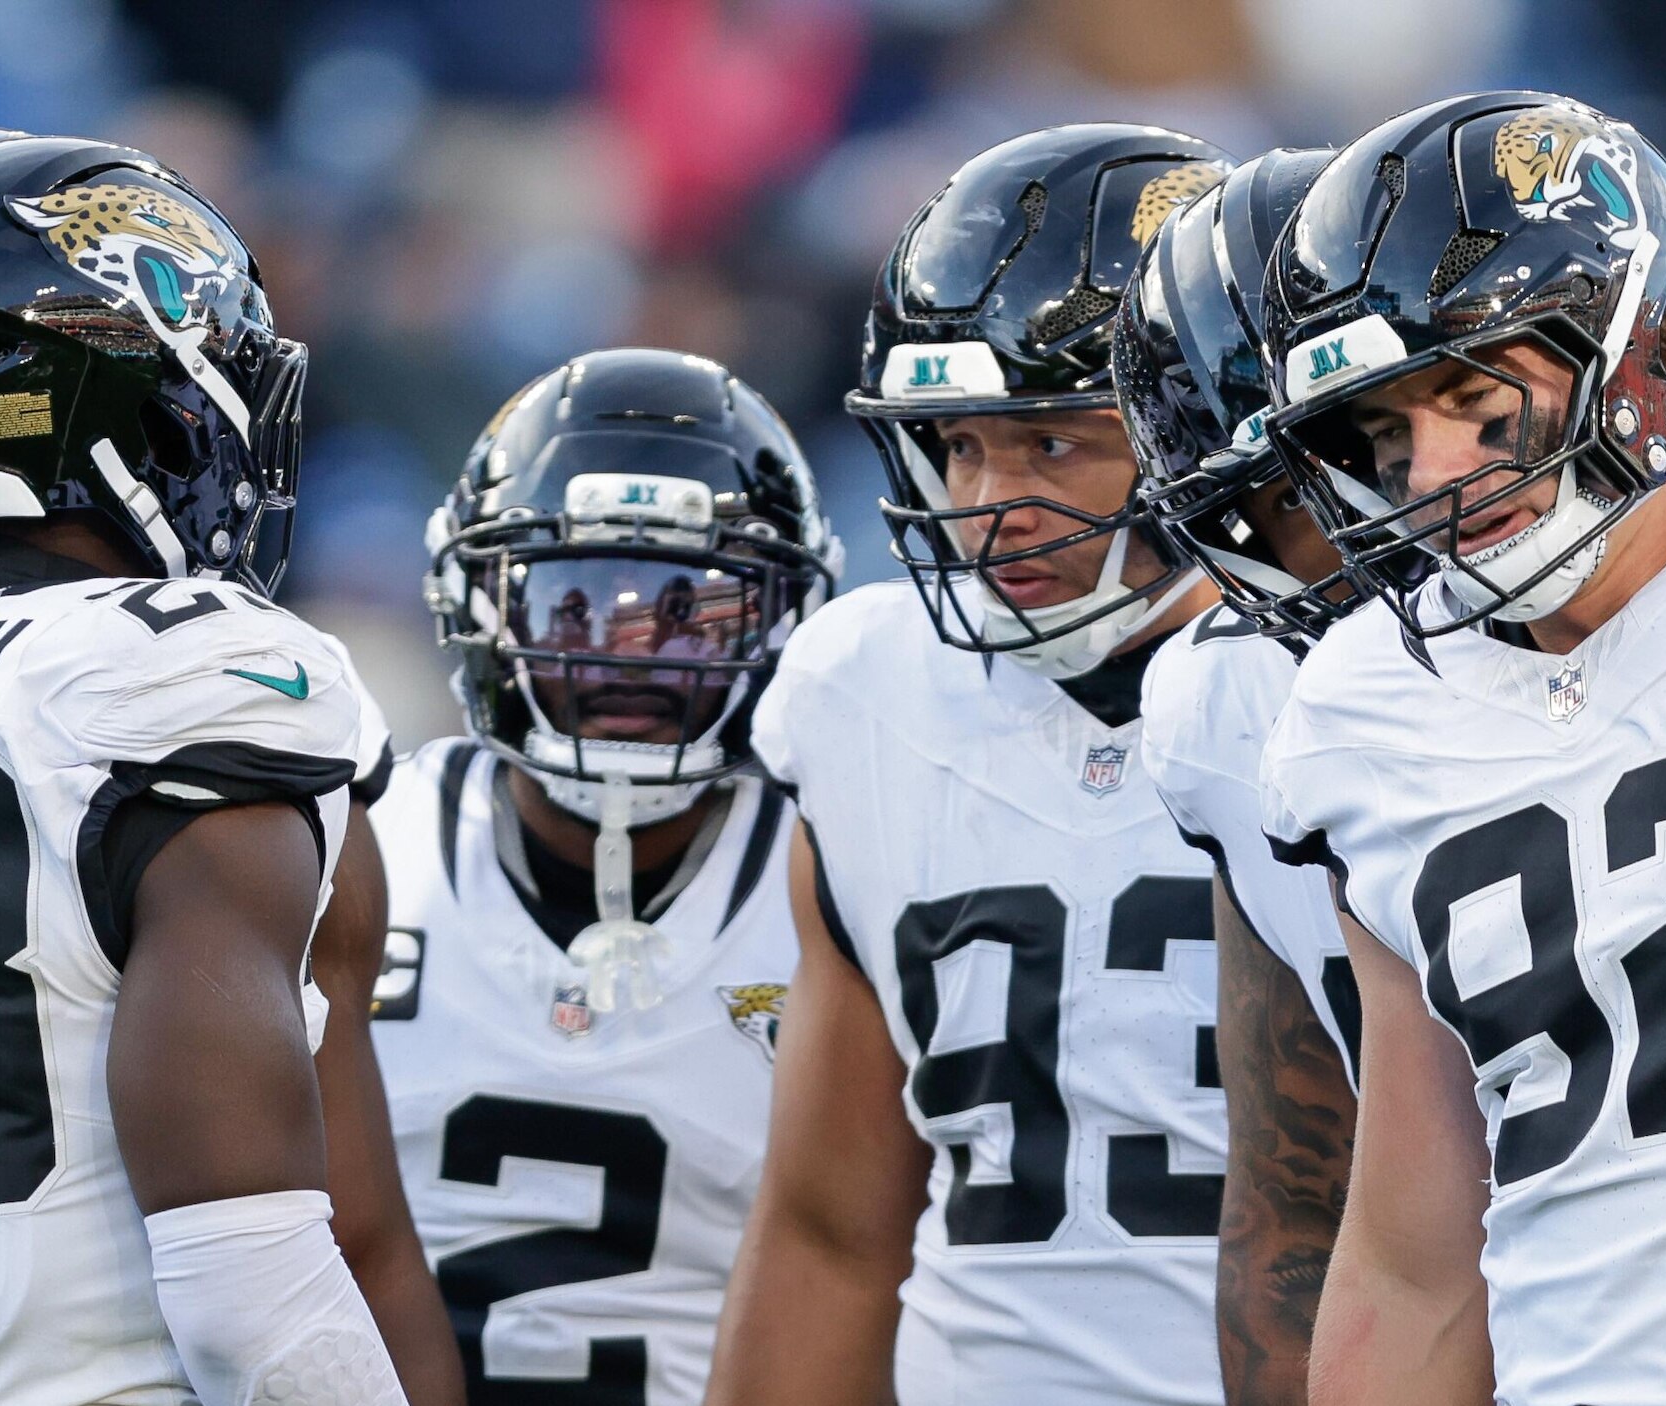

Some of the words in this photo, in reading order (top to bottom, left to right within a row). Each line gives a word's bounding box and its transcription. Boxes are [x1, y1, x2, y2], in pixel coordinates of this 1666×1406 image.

[908, 355, 950, 386] JAX
[1309, 337, 1351, 380] JAX
[1247, 406, 1270, 442] JA
[619, 483, 658, 505] JAX
[1553, 687, 1582, 711] NFL
[1086, 763, 1117, 787] NFL
[894, 876, 1226, 1246] 93
